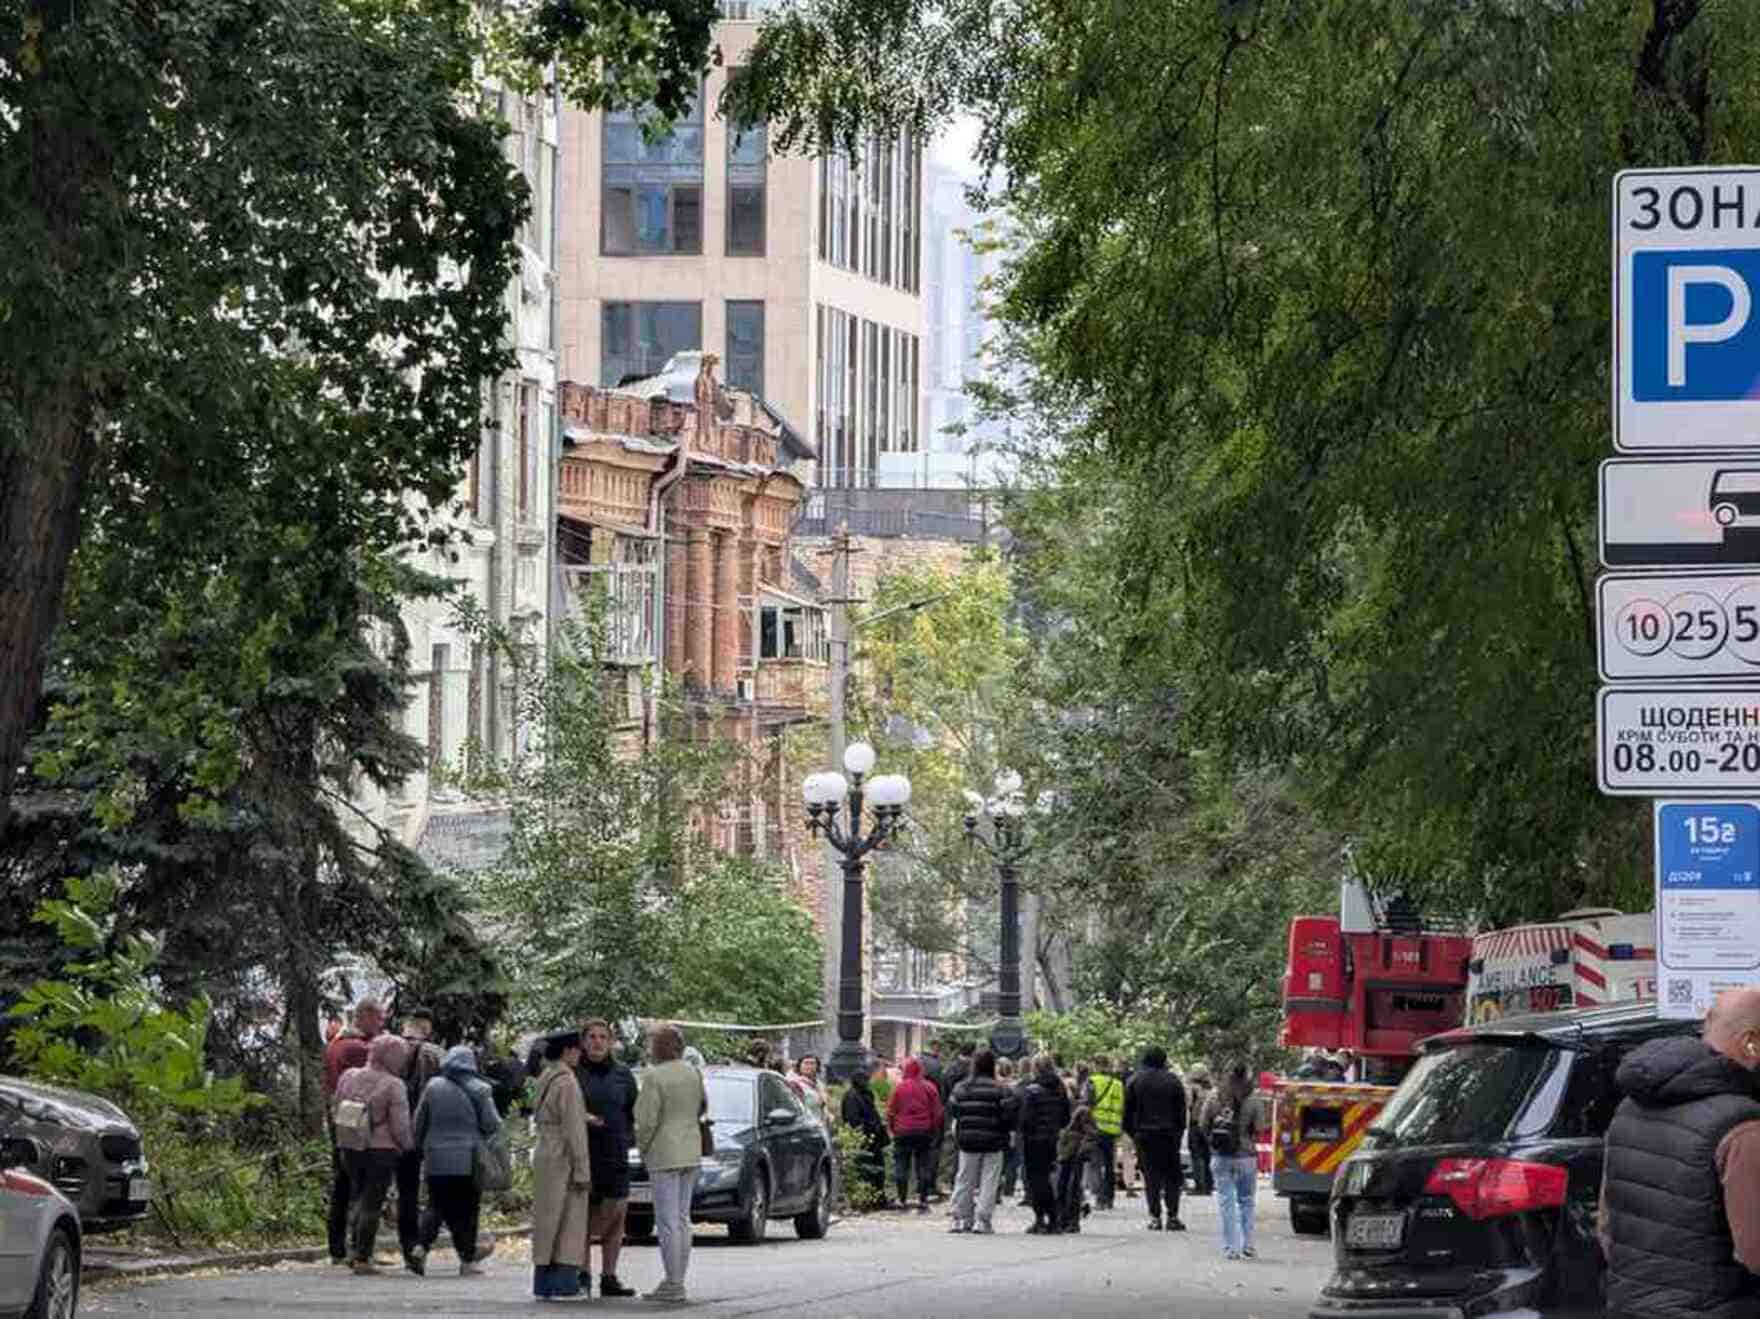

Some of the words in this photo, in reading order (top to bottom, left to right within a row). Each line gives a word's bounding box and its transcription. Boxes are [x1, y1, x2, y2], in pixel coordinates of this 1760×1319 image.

[1630, 185, 1760, 230] ЗОН
[1667, 265, 1751, 387] P
[1626, 613, 1659, 641] 10
[1675, 611, 1718, 641] 25
[1735, 605, 1759, 643] 5
[1640, 707, 1760, 730] ЩОДЕНН
[1657, 730, 1719, 743] СУБОТИ
[1725, 730, 1743, 742] ТА
